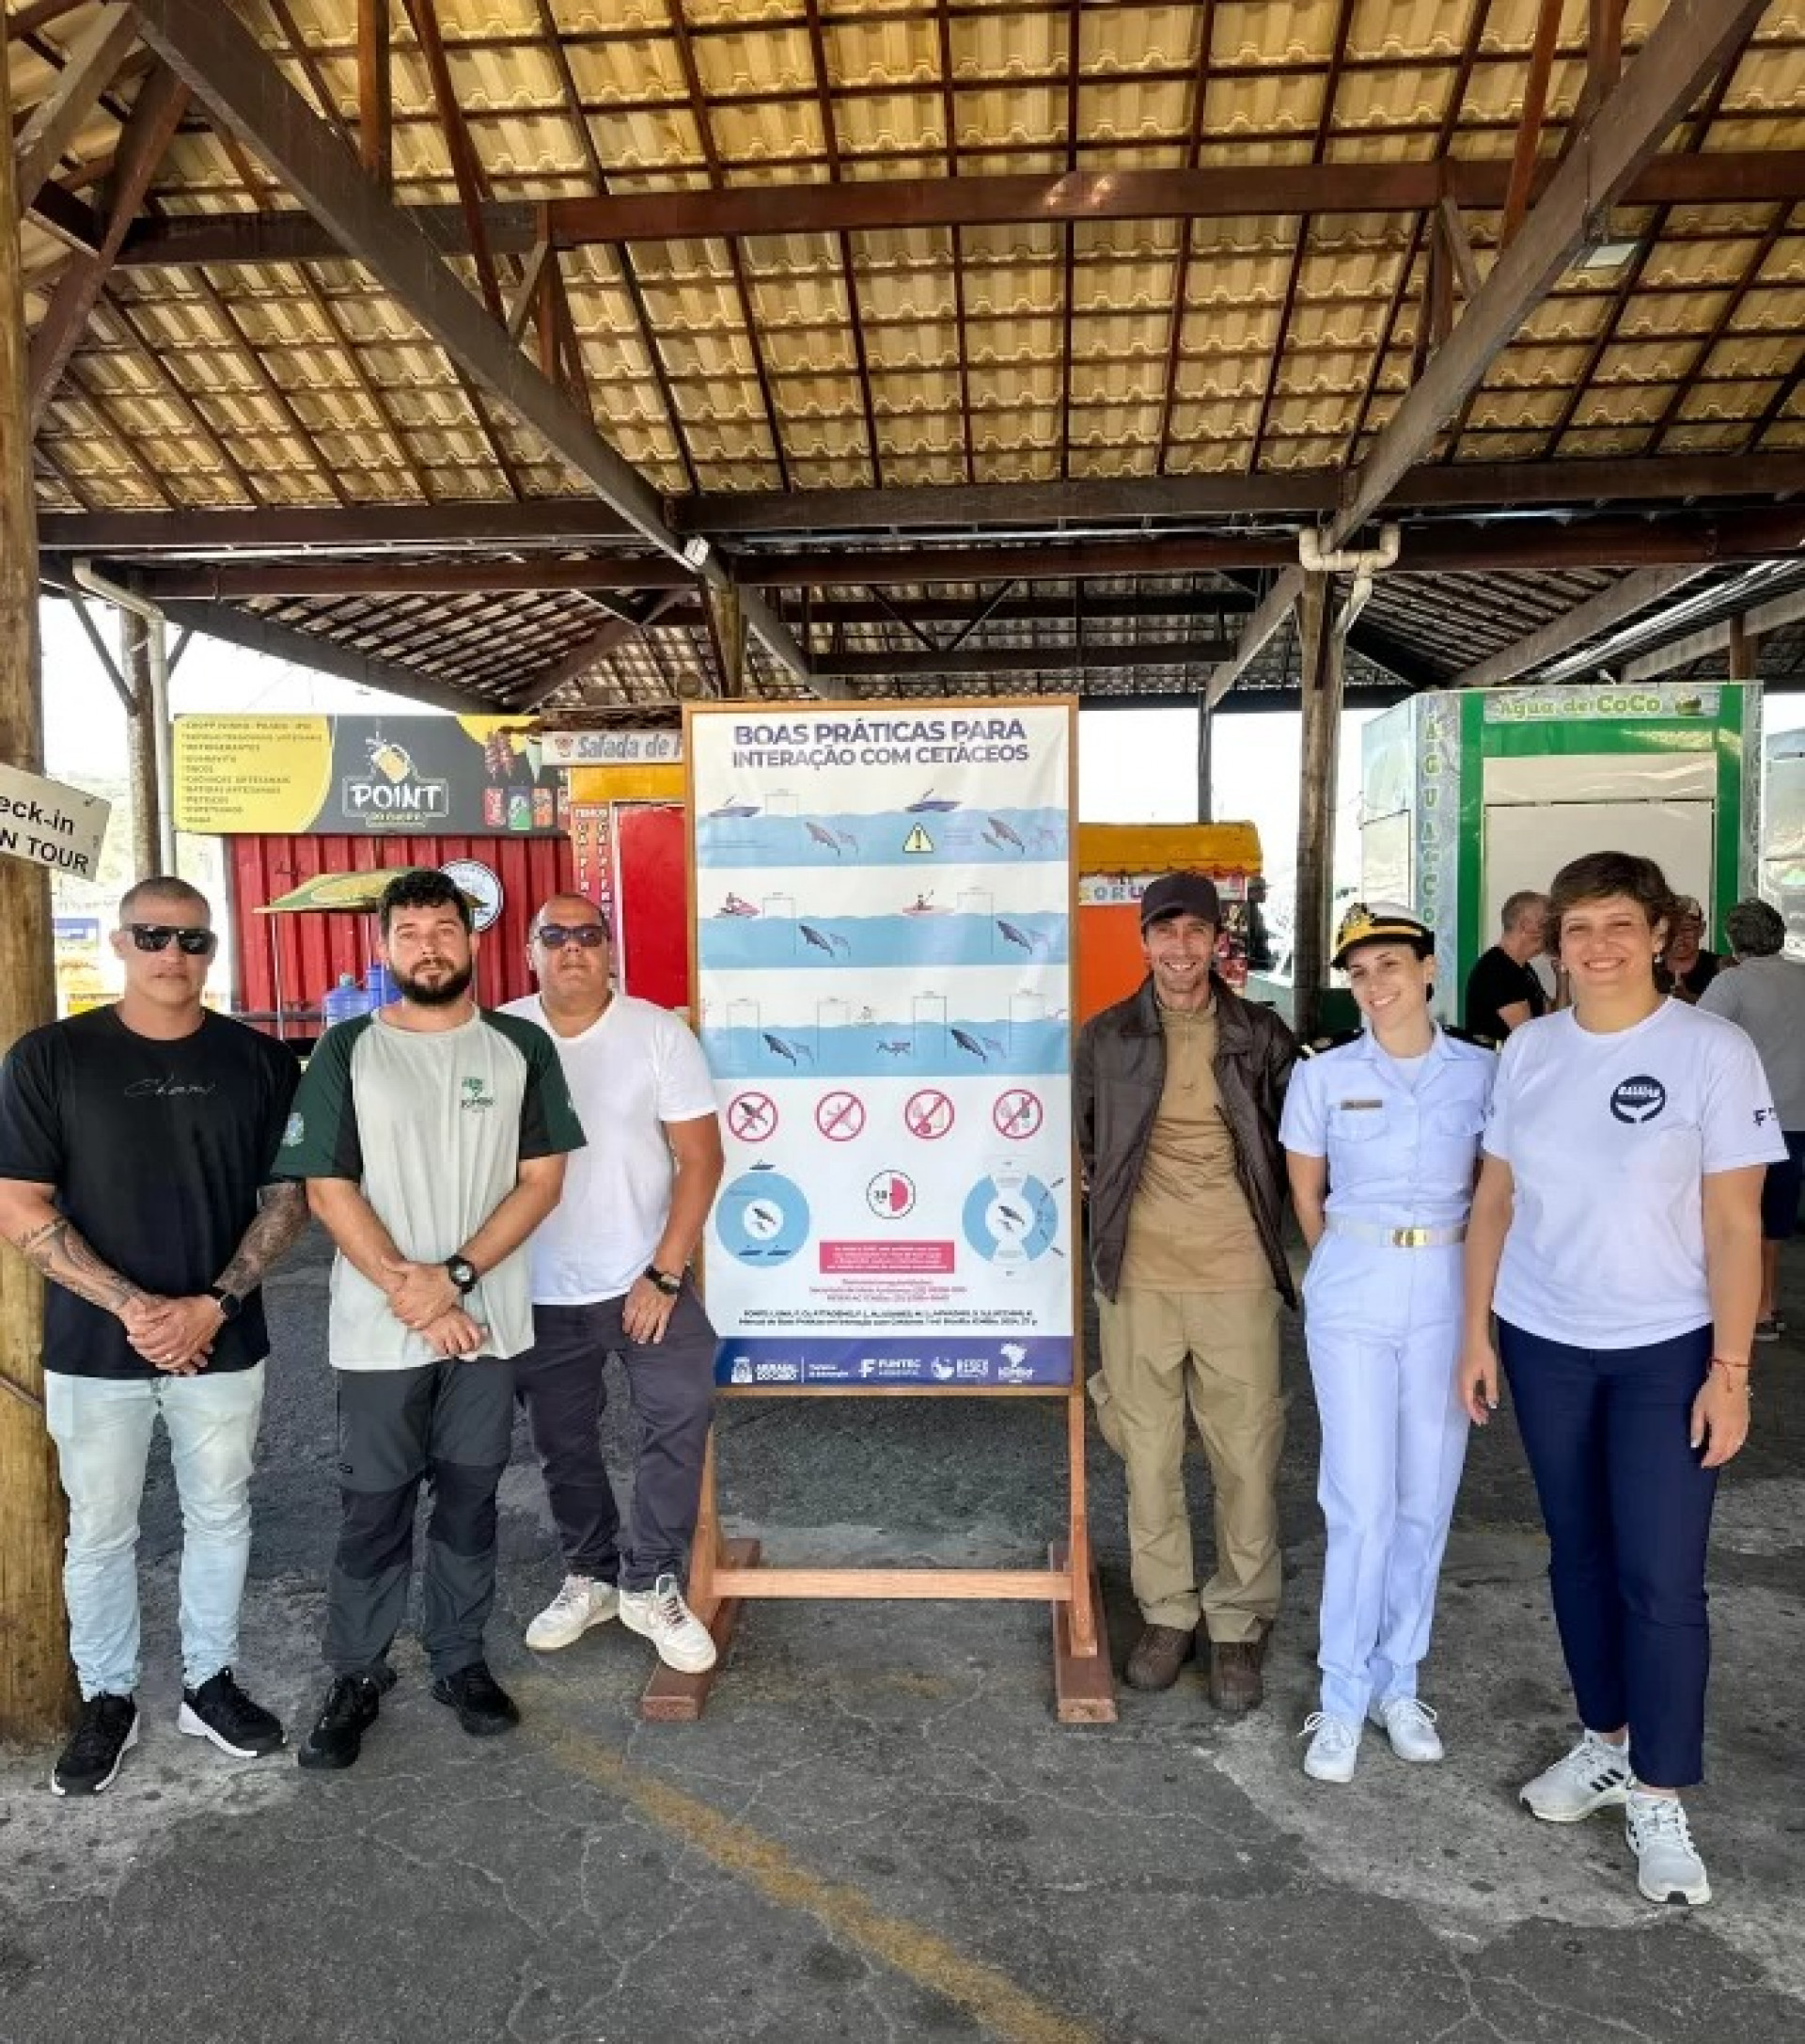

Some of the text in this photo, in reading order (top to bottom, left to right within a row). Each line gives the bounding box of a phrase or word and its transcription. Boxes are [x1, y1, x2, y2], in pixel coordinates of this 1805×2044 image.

[645, 733, 669, 758] de
[733, 717, 1027, 746] BOAS PRÁTICAS PARA
[733, 742, 1029, 771] INTERAÇÃO COM CETÁCEOS
[350, 783, 442, 810] POINT
[26, 835, 89, 875] TOUR
